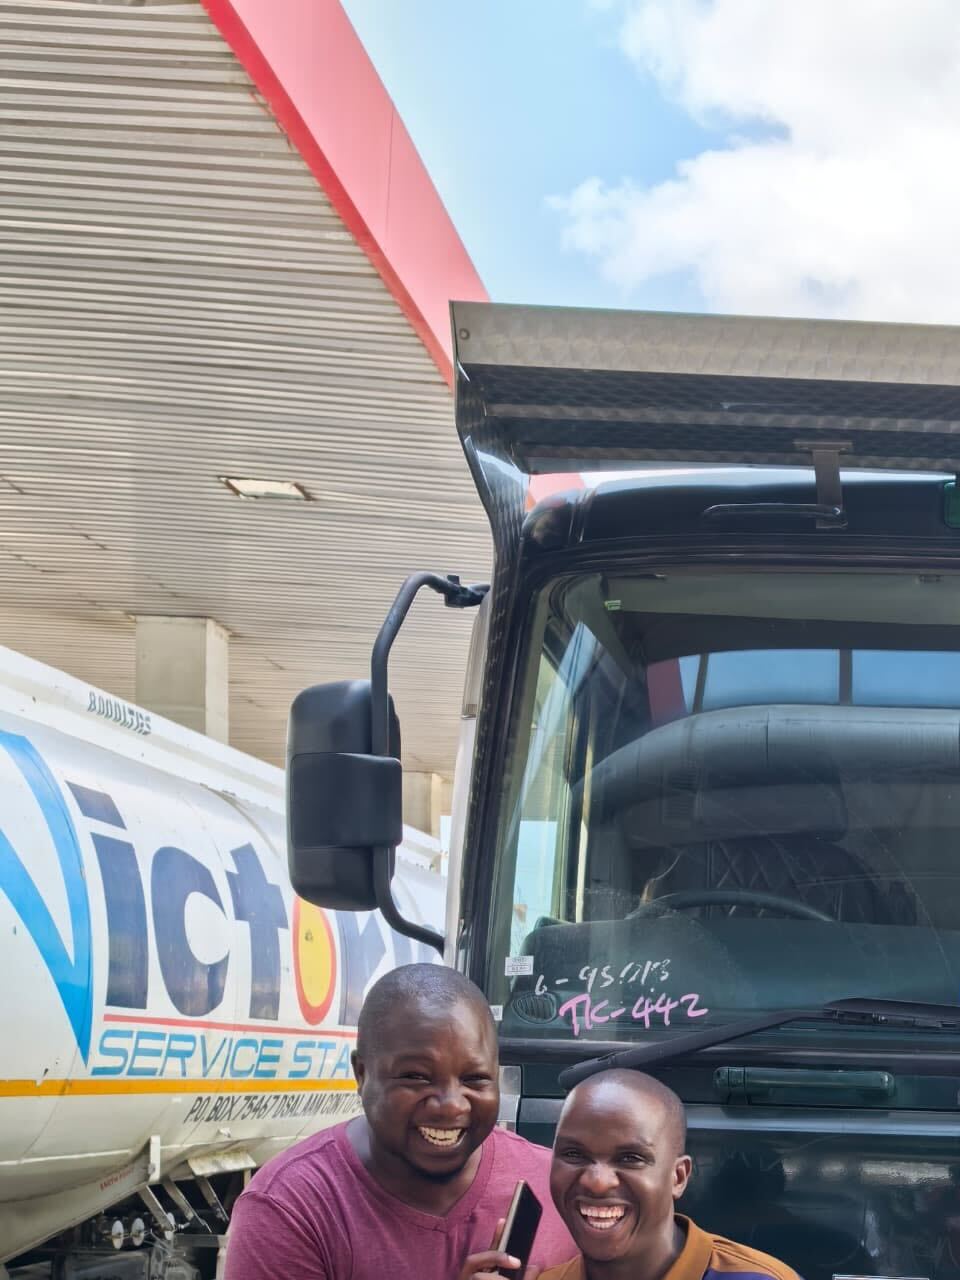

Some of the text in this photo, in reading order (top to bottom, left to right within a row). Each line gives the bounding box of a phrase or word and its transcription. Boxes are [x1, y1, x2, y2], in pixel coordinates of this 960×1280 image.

[559, 993, 709, 1036] TK-442
[92, 1029, 359, 1080] SERVICE STA
